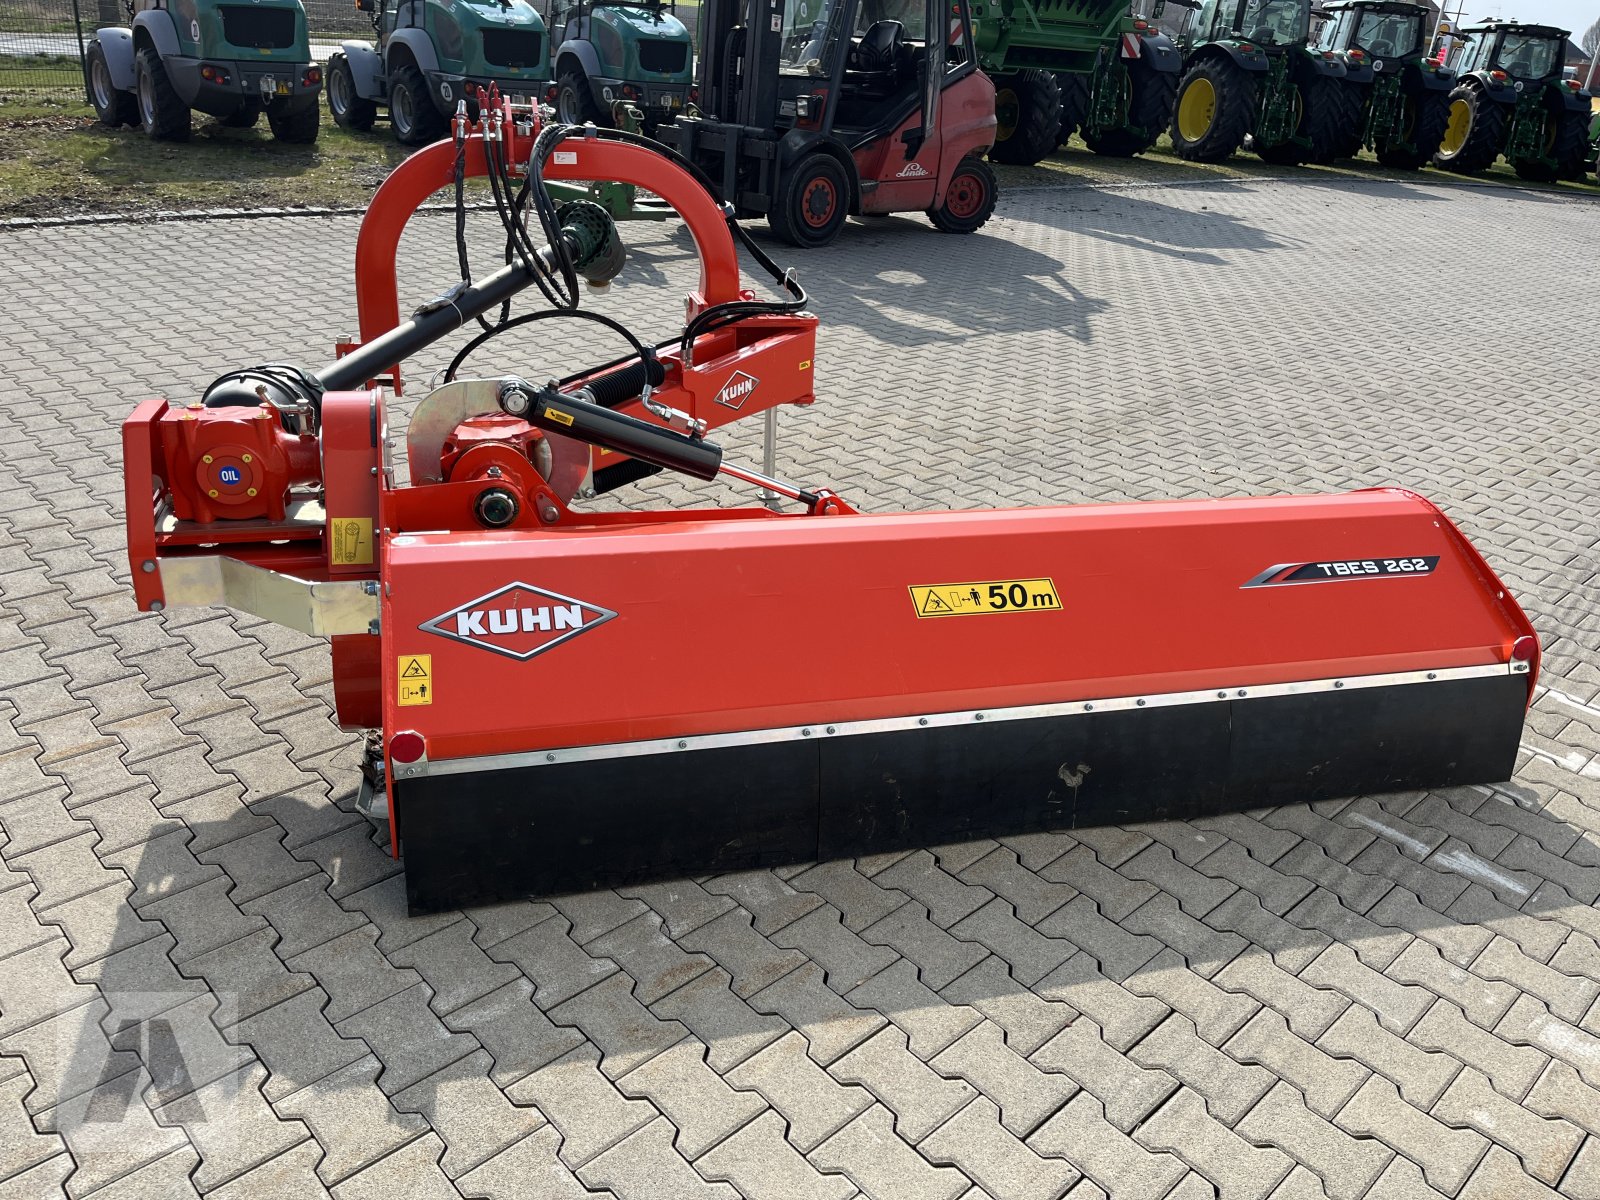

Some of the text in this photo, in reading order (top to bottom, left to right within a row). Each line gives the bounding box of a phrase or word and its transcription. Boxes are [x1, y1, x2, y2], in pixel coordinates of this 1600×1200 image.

[895, 162, 928, 178] Linde
[722, 379, 753, 403] KUHN
[221, 470, 239, 481] OIL
[1317, 558, 1429, 576] TBES 262
[988, 583, 1028, 609] 50
[457, 605, 583, 636] KUHN
